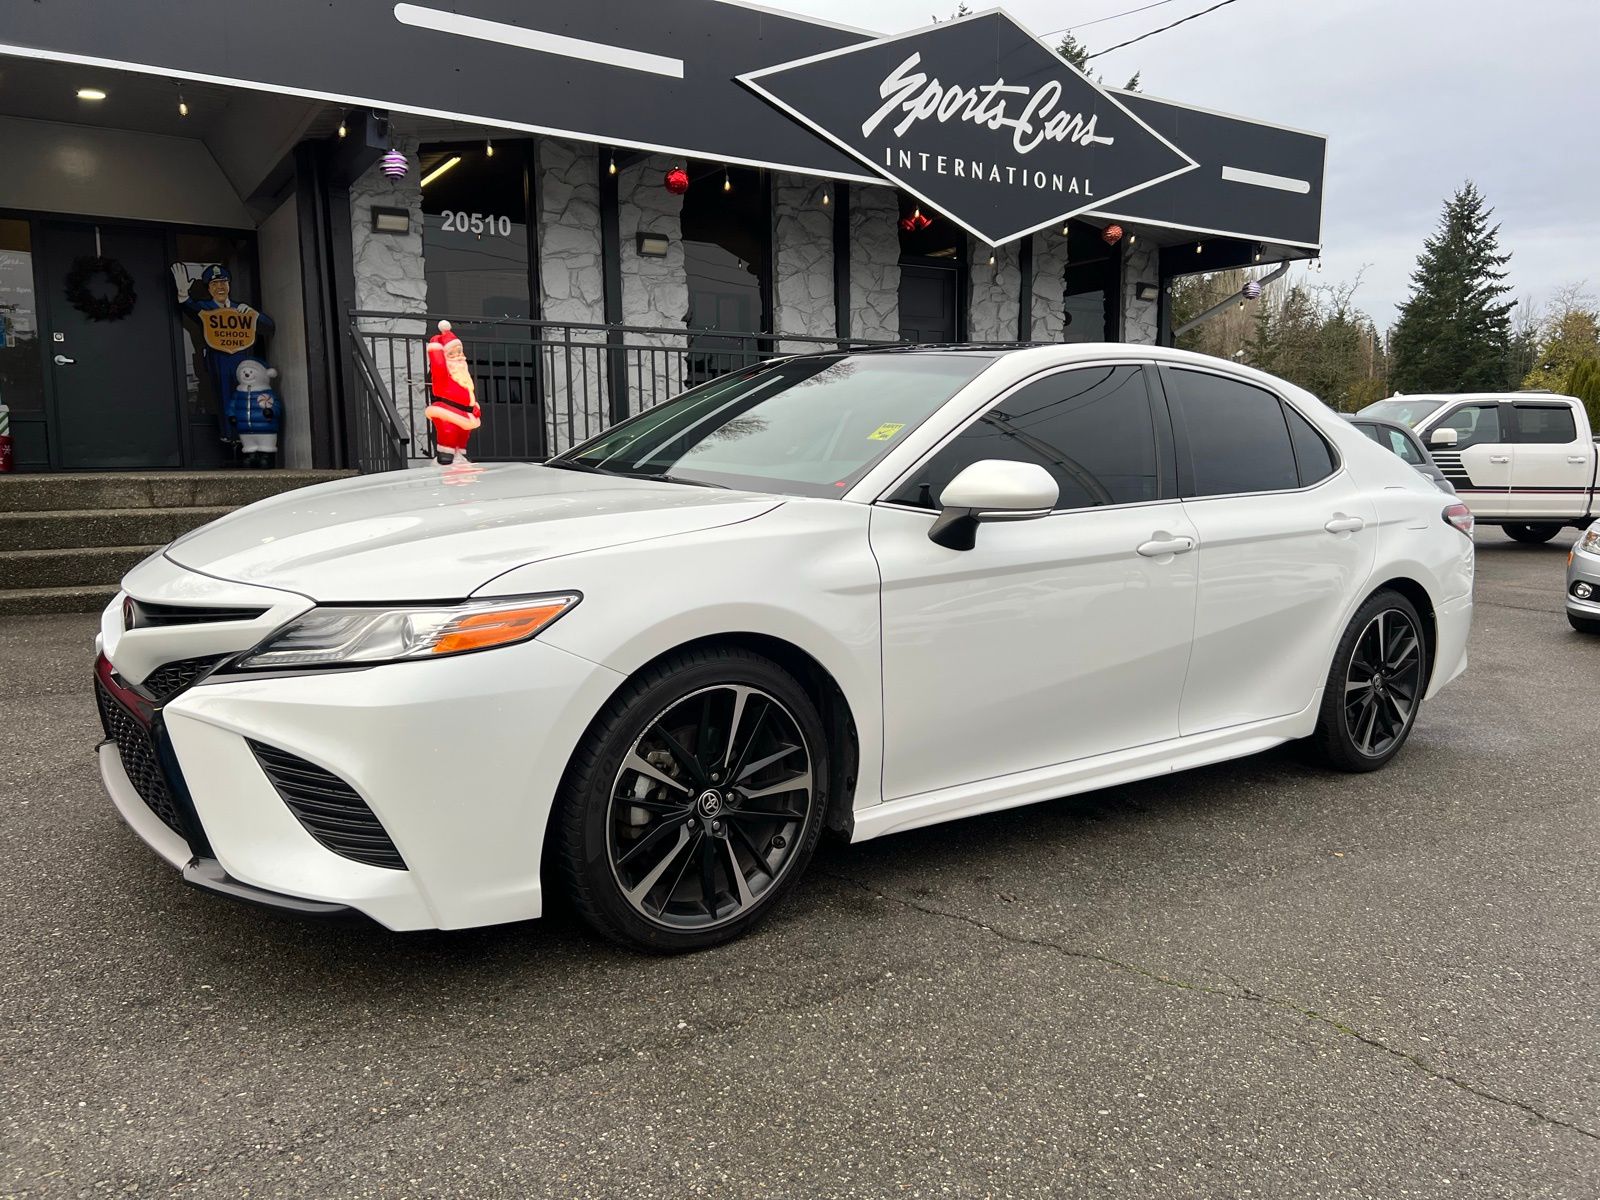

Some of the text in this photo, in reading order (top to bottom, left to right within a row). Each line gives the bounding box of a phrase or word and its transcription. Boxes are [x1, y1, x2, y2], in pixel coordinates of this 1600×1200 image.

[861, 51, 1114, 154] Sports Cars
[886, 147, 1094, 197] INTERNATIONAL
[442, 210, 511, 236] 20510
[209, 315, 252, 329] SLOW
[214, 330, 250, 338] SCHOOL
